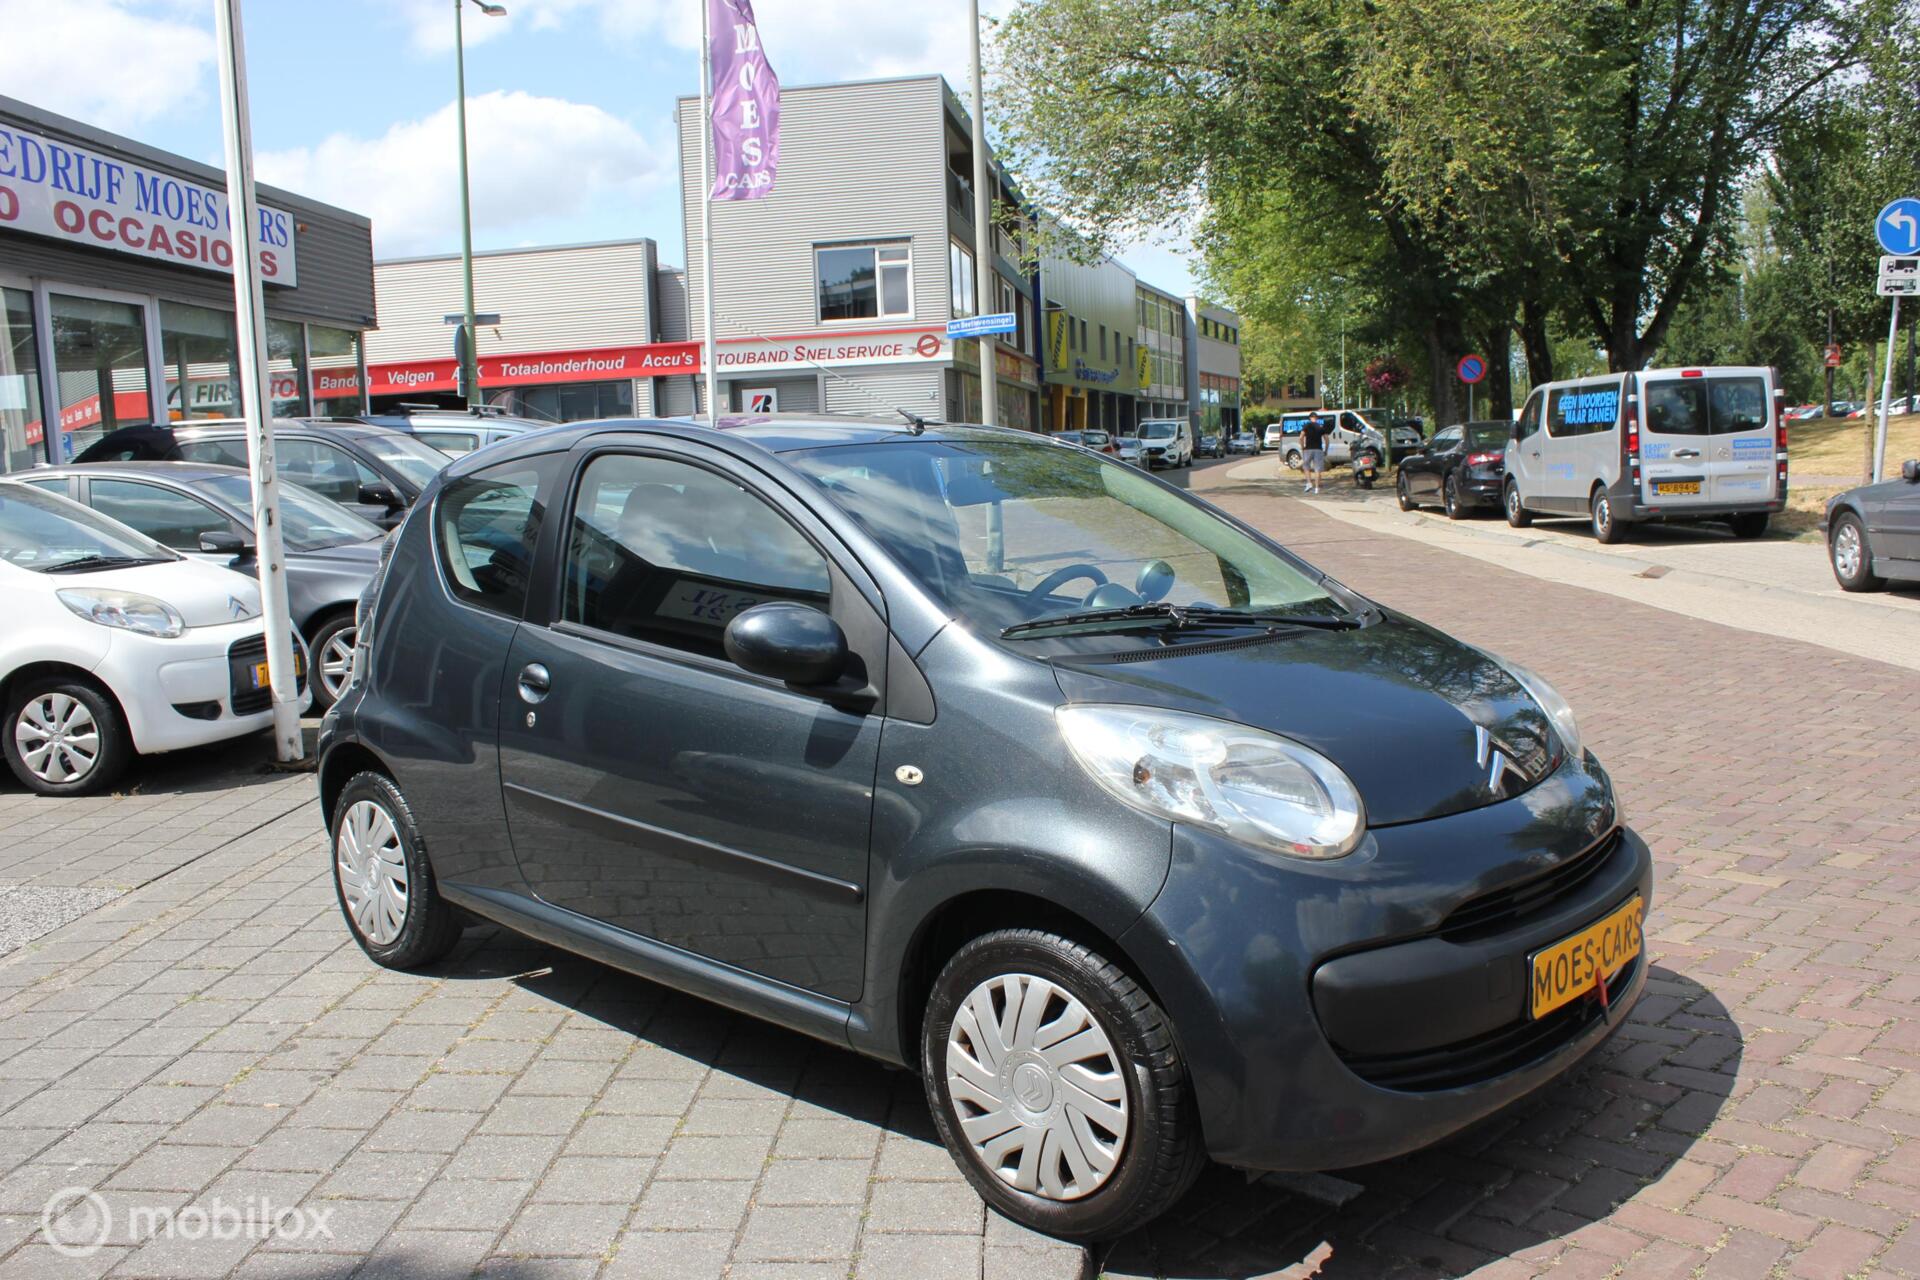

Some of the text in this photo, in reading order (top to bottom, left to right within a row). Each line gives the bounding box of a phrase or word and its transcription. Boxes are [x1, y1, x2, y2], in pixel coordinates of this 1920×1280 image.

[733, 22, 763, 168] MOES
[725, 169, 771, 189] CARS
[134, 171, 219, 230] MOES
[53, 200, 278, 277] OCCASIOS
[387, 369, 435, 387] Velgen
[500, 355, 626, 377] Totaalonderhoud
[642, 351, 694, 368] Accu's
[703, 344, 903, 366] TOUBAND SNELSERVICE
[1558, 391, 1618, 411] GEEN WOORDEN
[1565, 406, 1617, 425] MAAR BANEN
[1535, 907, 1644, 1009] MOES-CARS
